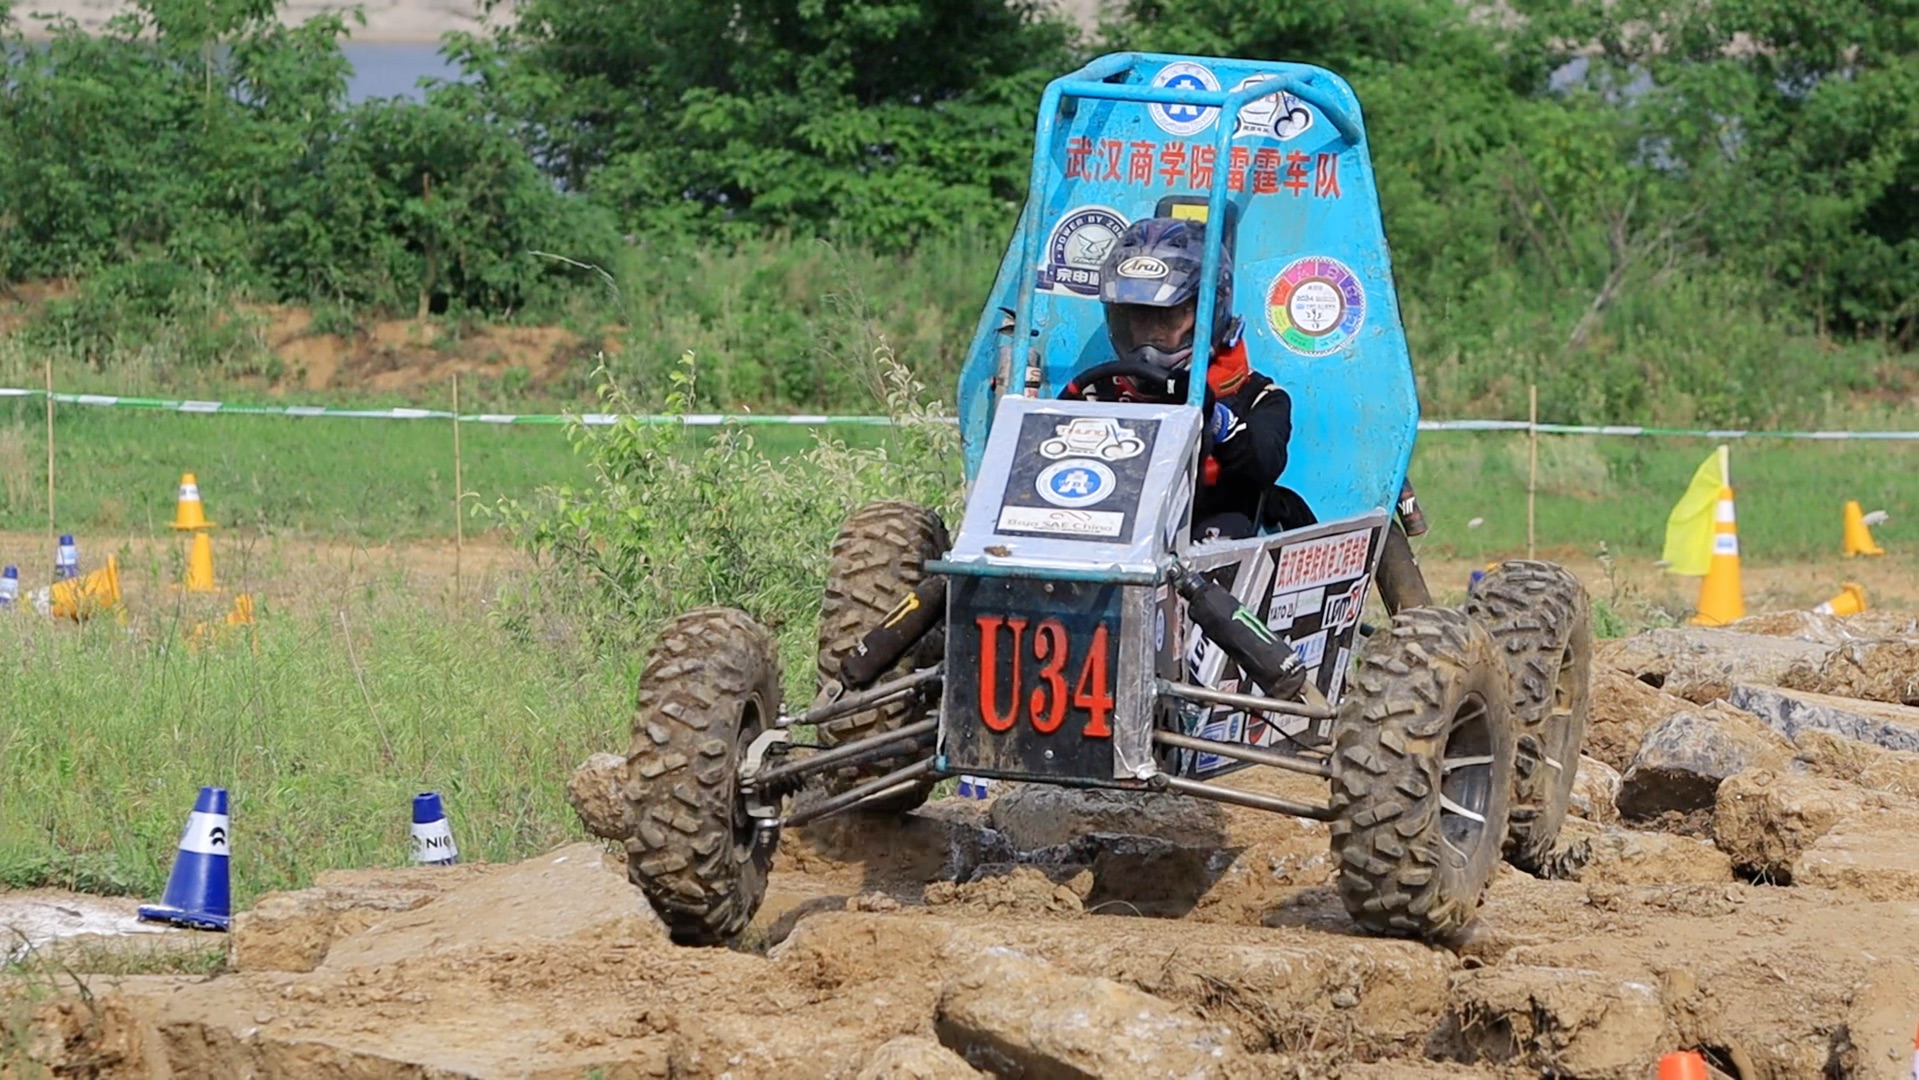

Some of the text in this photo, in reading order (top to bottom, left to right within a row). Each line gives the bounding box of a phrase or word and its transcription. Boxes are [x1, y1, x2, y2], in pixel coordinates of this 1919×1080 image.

[1065, 135, 1341, 199] 武汉商学院雷霆车队
[1057, 218, 1085, 247] POWER
[1088, 215, 1103, 224] BY
[1127, 258, 1160, 271] Arai
[1043, 519, 1068, 529] SAE
[976, 616, 1114, 737] U34
